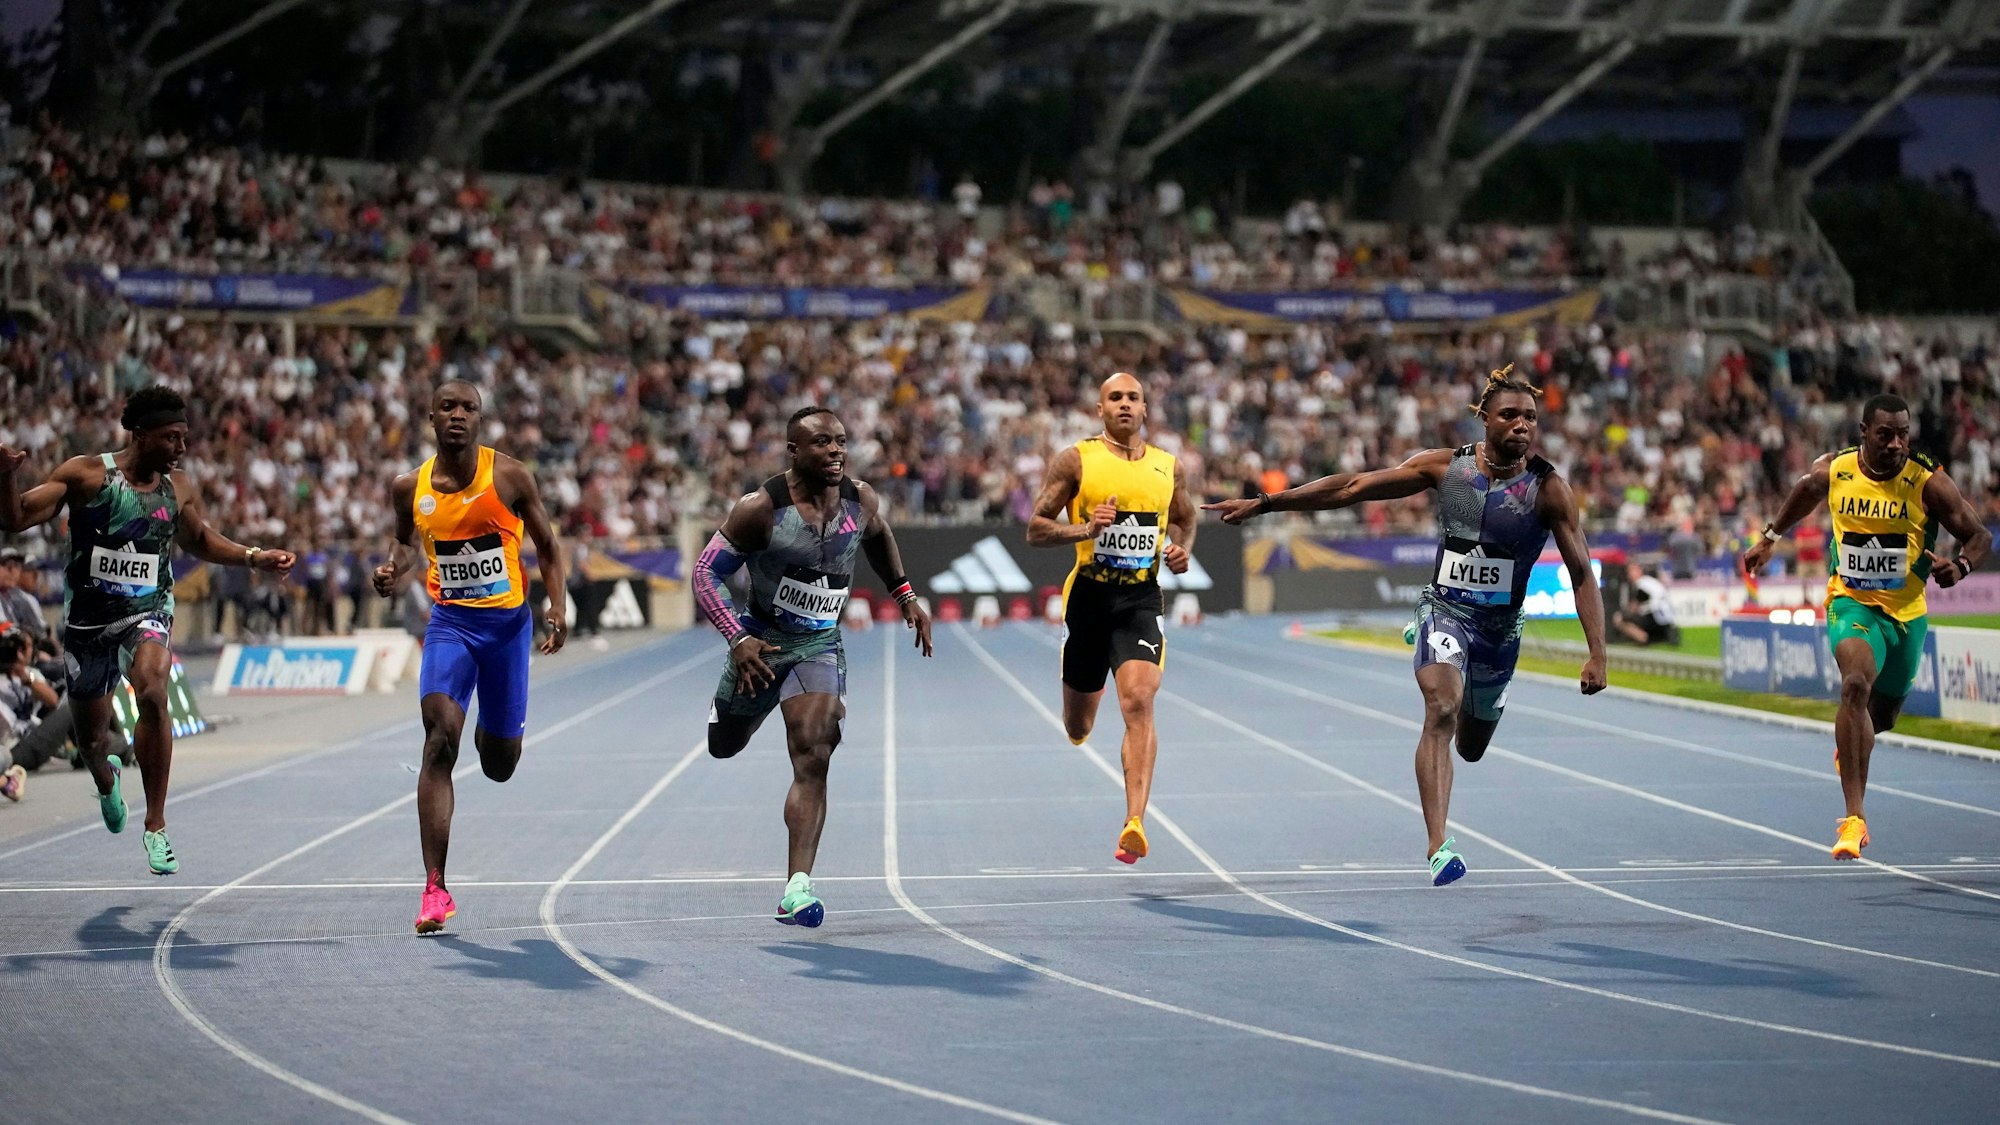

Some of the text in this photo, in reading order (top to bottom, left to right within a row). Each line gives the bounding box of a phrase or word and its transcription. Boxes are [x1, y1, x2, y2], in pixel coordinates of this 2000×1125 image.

[1838, 496, 1909, 520] JAMAICA
[1099, 532, 1154, 551] JACOBS
[99, 555, 150, 579] BAKER
[440, 556, 503, 581] TEBOGO
[1449, 561, 1501, 585] LYLES
[1848, 553, 1898, 573] BLAKE
[463, 587, 488, 597] PARIS
[779, 584, 841, 614] OMANYALA
[1461, 591, 1486, 601] PARIS
[1440, 637, 1451, 650] 4
